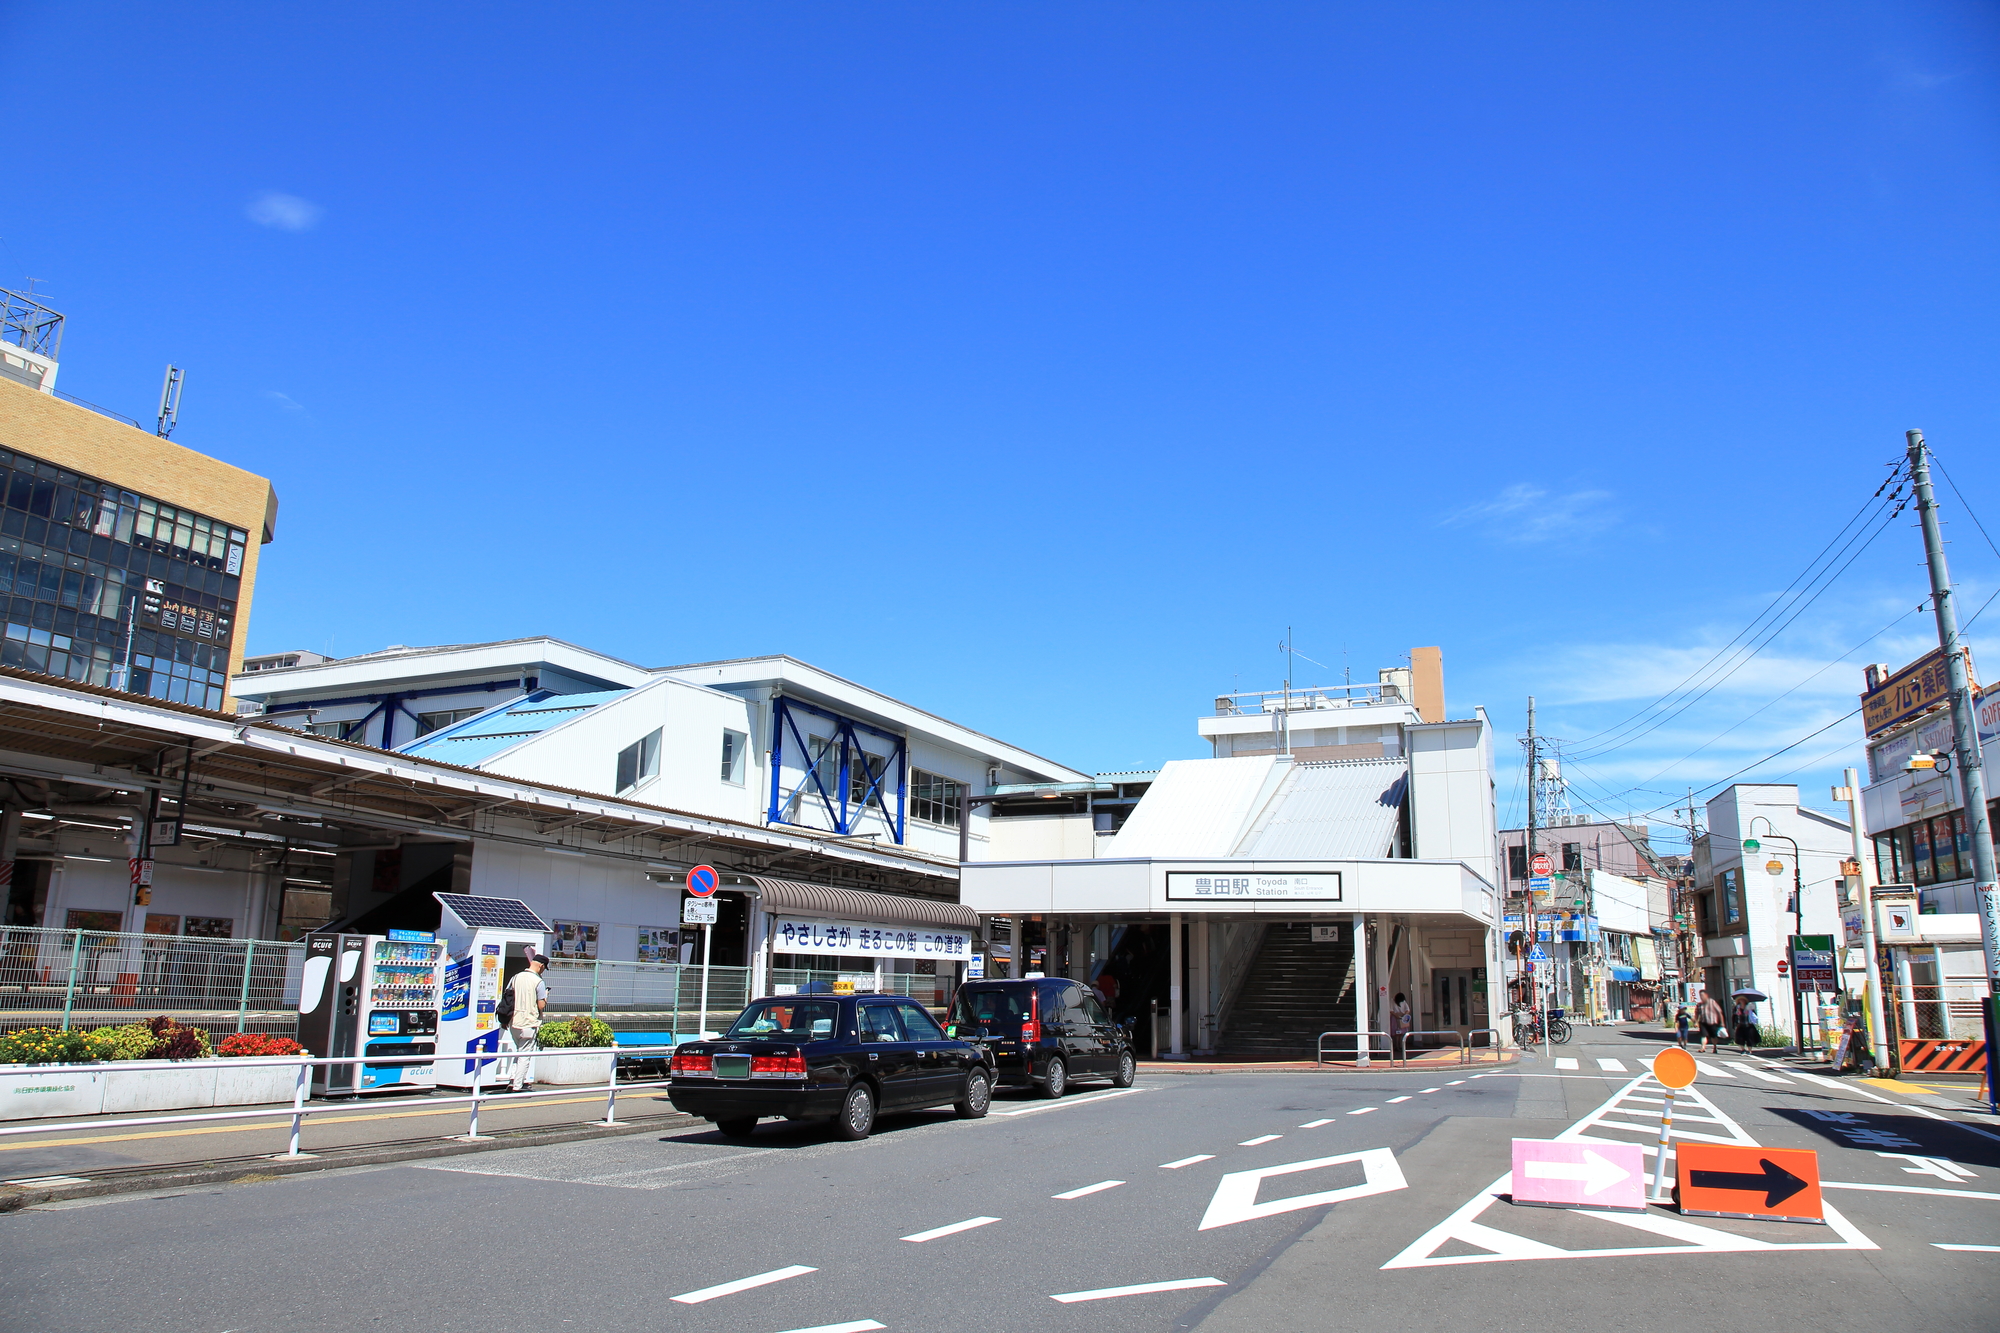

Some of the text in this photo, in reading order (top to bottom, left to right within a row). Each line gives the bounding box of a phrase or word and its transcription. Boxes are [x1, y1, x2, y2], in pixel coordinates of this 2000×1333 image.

[1195, 878, 1250, 895] 豊田駅
[1256, 878, 1288, 888] Toyoda
[1256, 888, 1288, 896] Station
[782, 923, 963, 954] やさしさが 走るこの街 この道路
[312, 941, 333, 949] acure
[1798, 970, 1832, 979] 酒・たばこ
[1798, 982, 1833, 990] 銀行TM
[409, 1068, 434, 1076] acure
